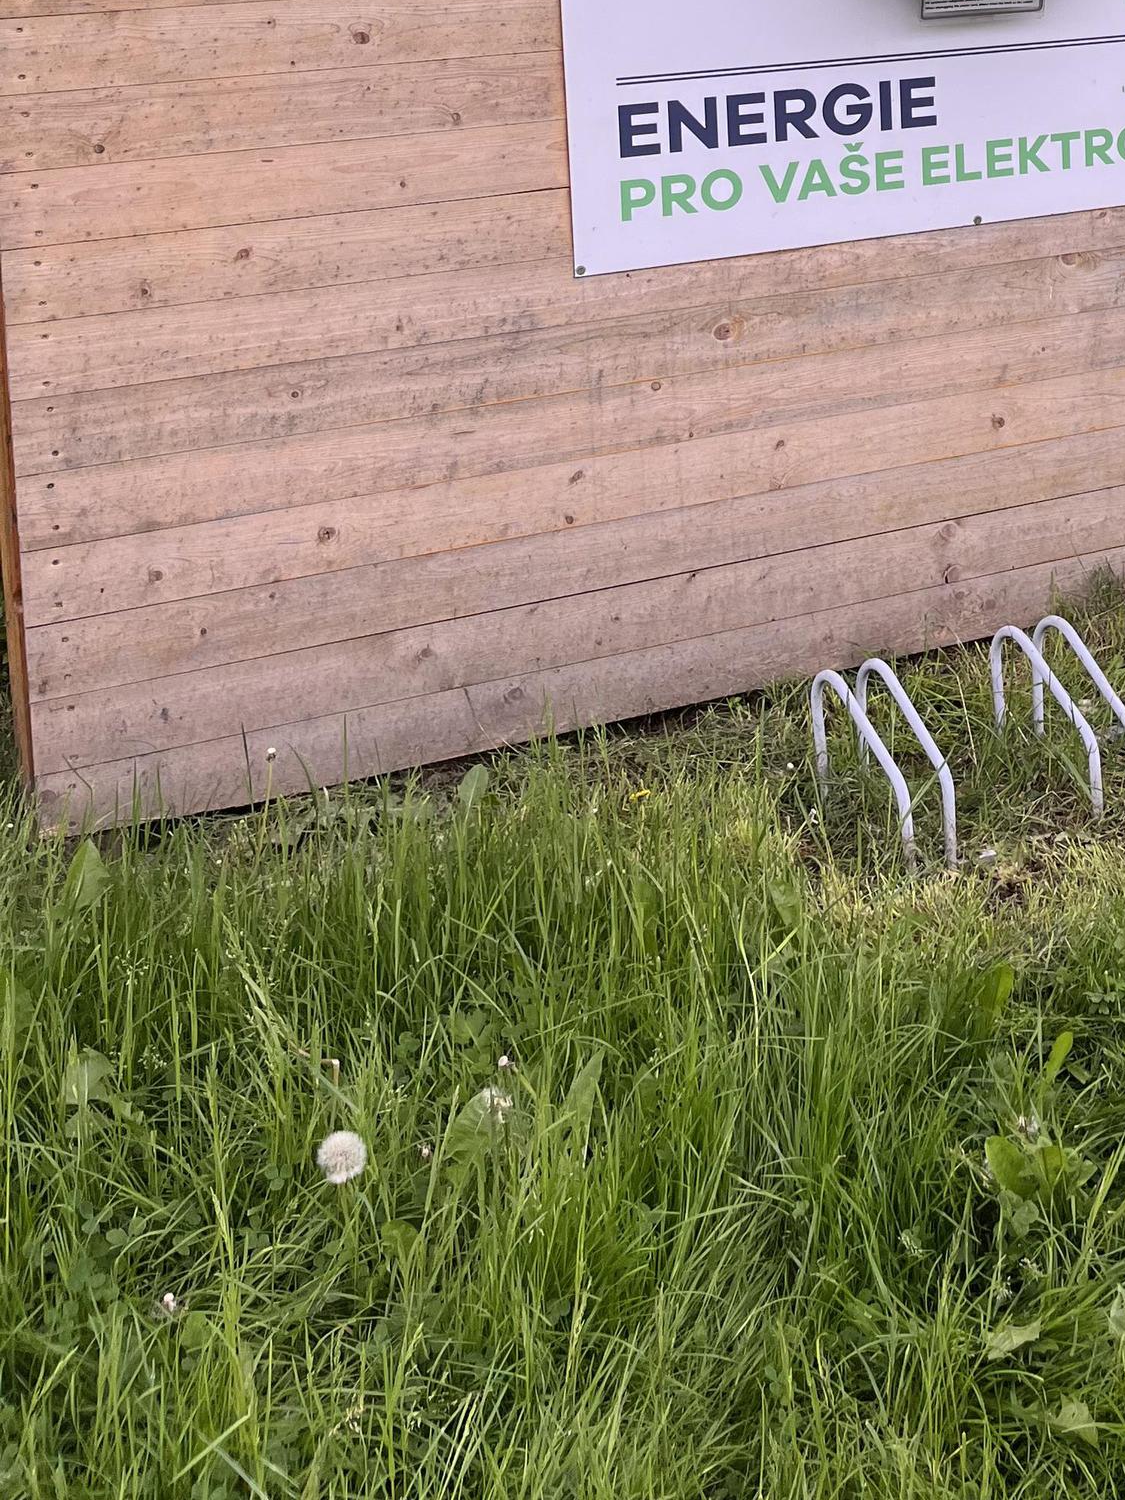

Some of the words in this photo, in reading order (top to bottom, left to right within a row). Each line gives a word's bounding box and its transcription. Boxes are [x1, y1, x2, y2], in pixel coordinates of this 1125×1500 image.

[618, 76, 937, 158] ENERGIE
[620, 168, 743, 222] PRO
[758, 141, 905, 203] VAŠE
